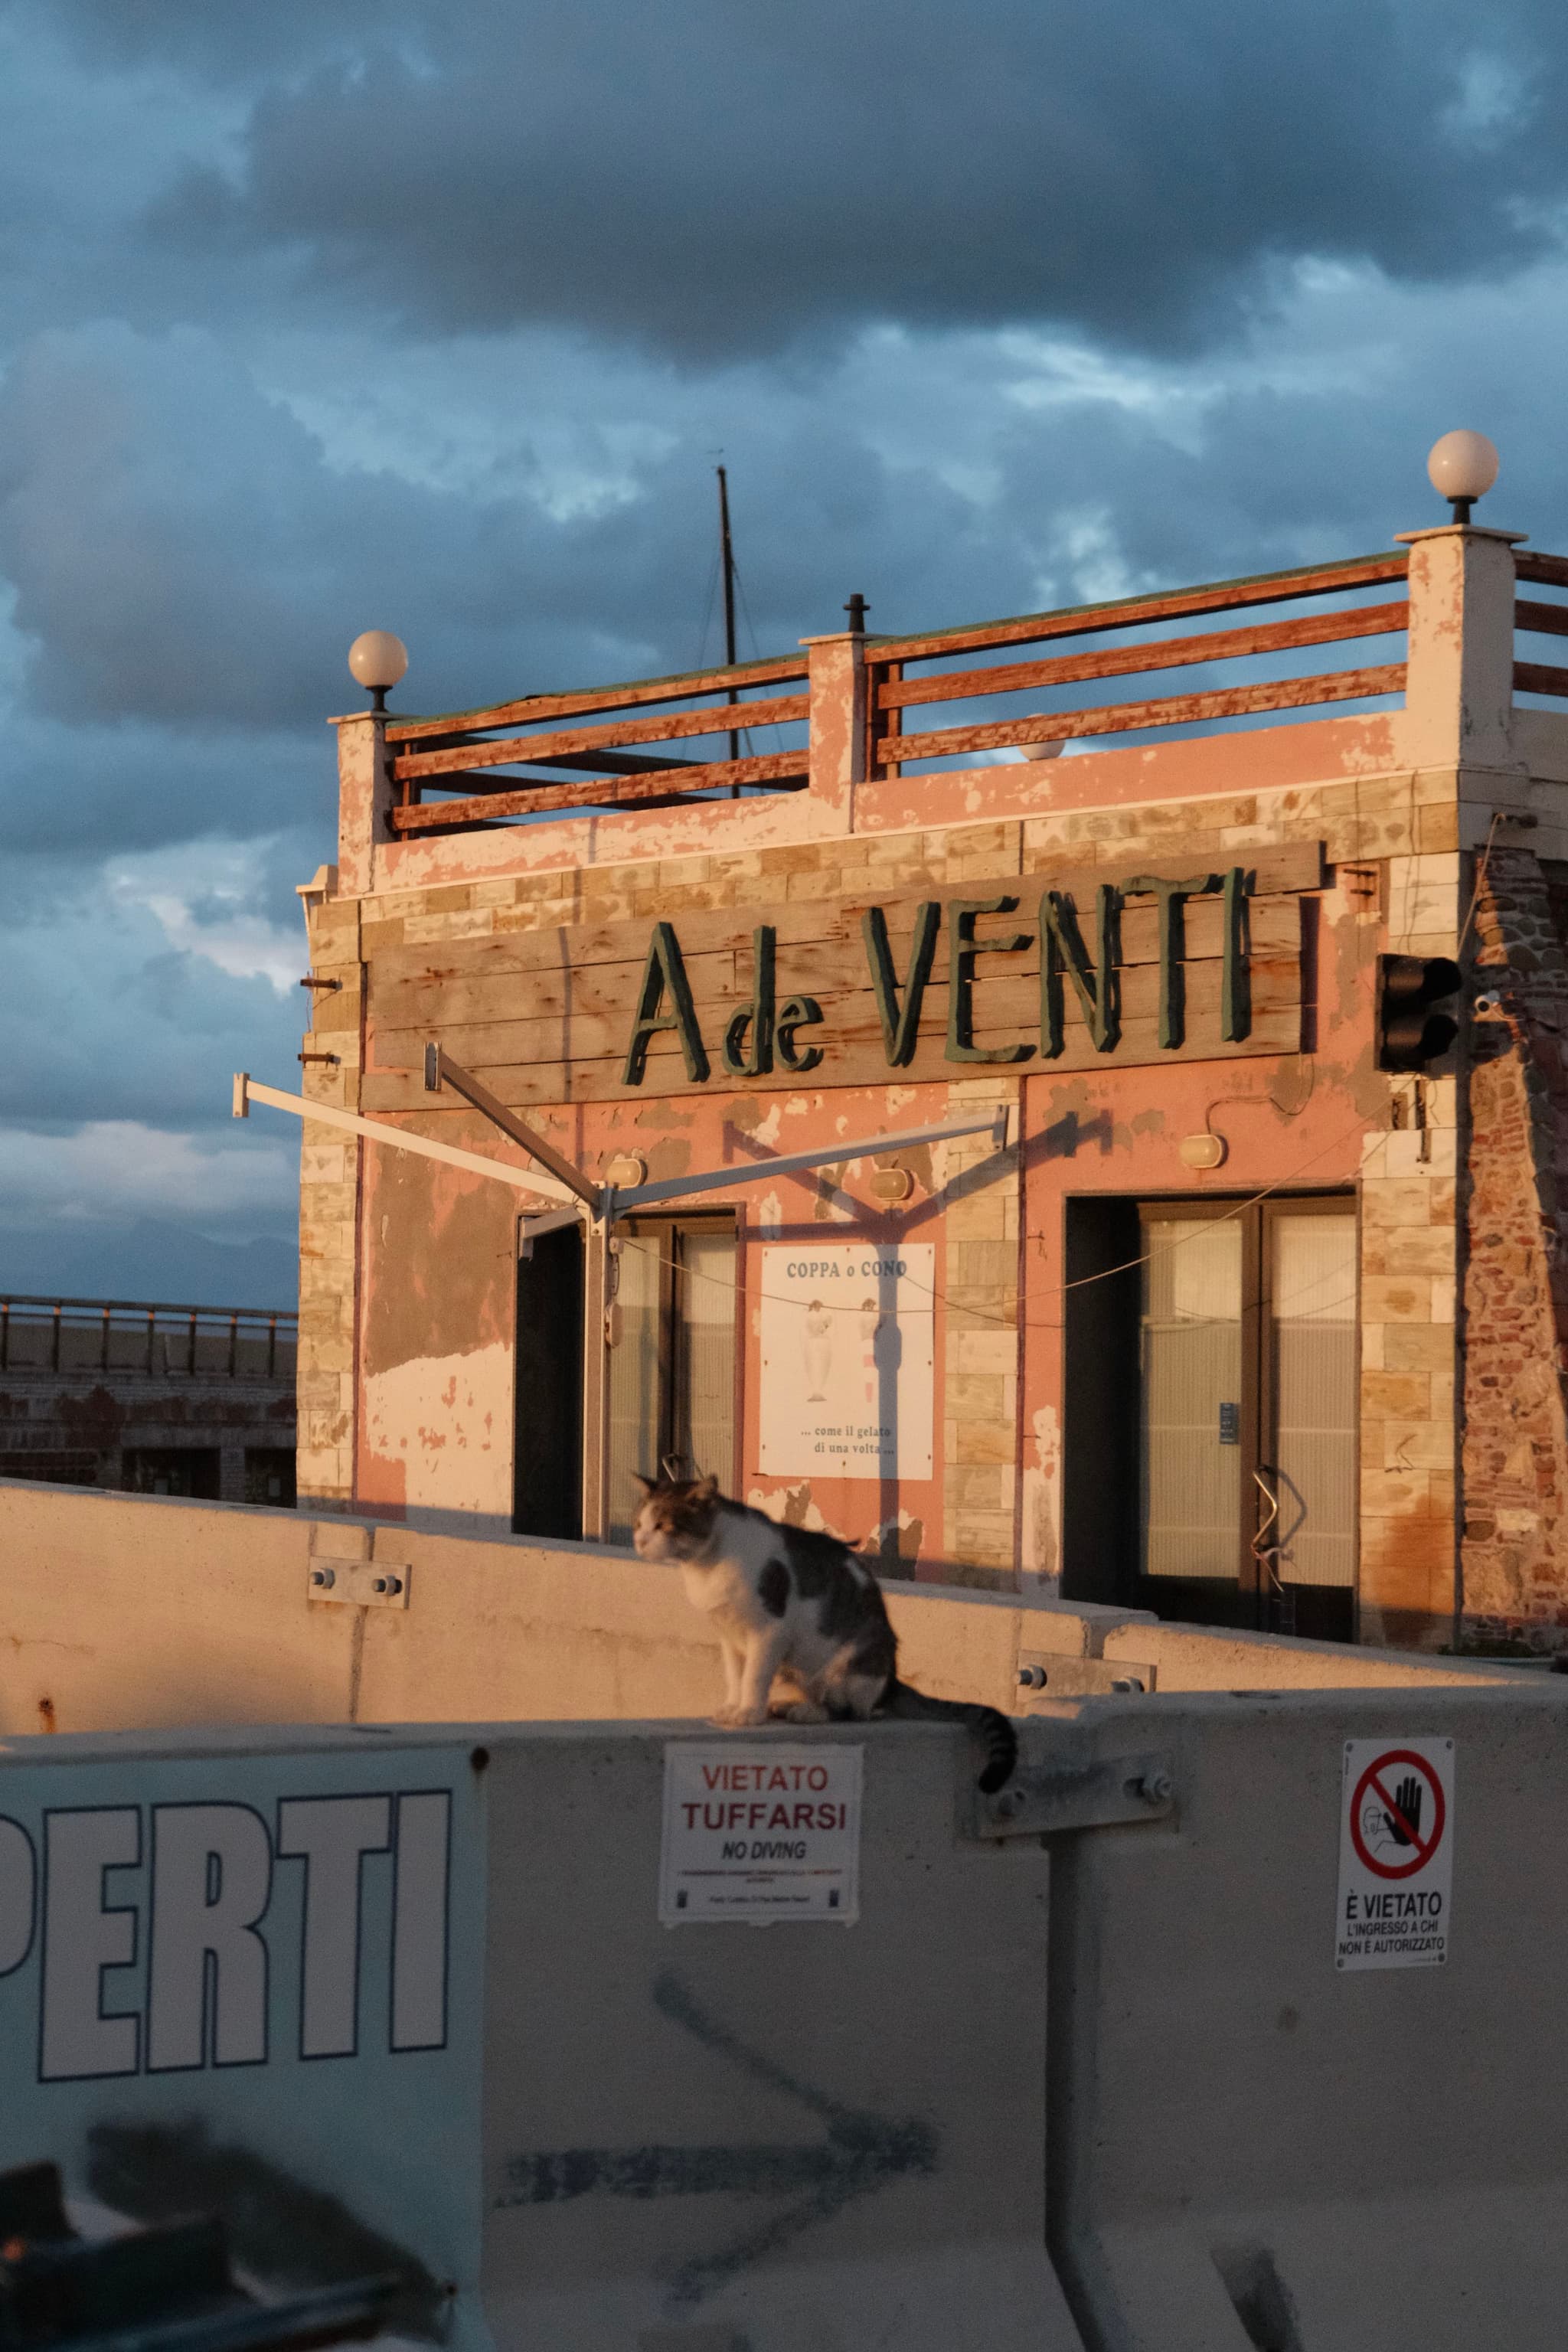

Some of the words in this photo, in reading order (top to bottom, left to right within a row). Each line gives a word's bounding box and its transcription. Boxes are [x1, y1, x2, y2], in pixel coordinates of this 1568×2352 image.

[862, 867, 1251, 1067] VENTI
[787, 1262, 841, 1278] COPPA
[861, 1260, 907, 1277] CONO
[815, 1427, 842, 1436] come
[845, 1426, 854, 1436] il
[857, 1426, 891, 1439] gelato
[815, 1442, 825, 1453] di
[829, 1445, 849, 1454] una
[701, 1764, 829, 1792] VIETATO
[681, 1802, 847, 1831] TUFFARSI
[722, 1841, 748, 1860] NO
[750, 1841, 807, 1860] DIVING
[1346, 1889, 1358, 1919] È
[1364, 1891, 1442, 1919] VIETATO
[1348, 1921, 1409, 1937] L'INGRESSO
[1410, 1921, 1419, 1934] A
[1420, 1919, 1439, 1933] CHI
[1338, 1940, 1362, 1955] NON
[1374, 1936, 1445, 1953] AUTORIZZATO
